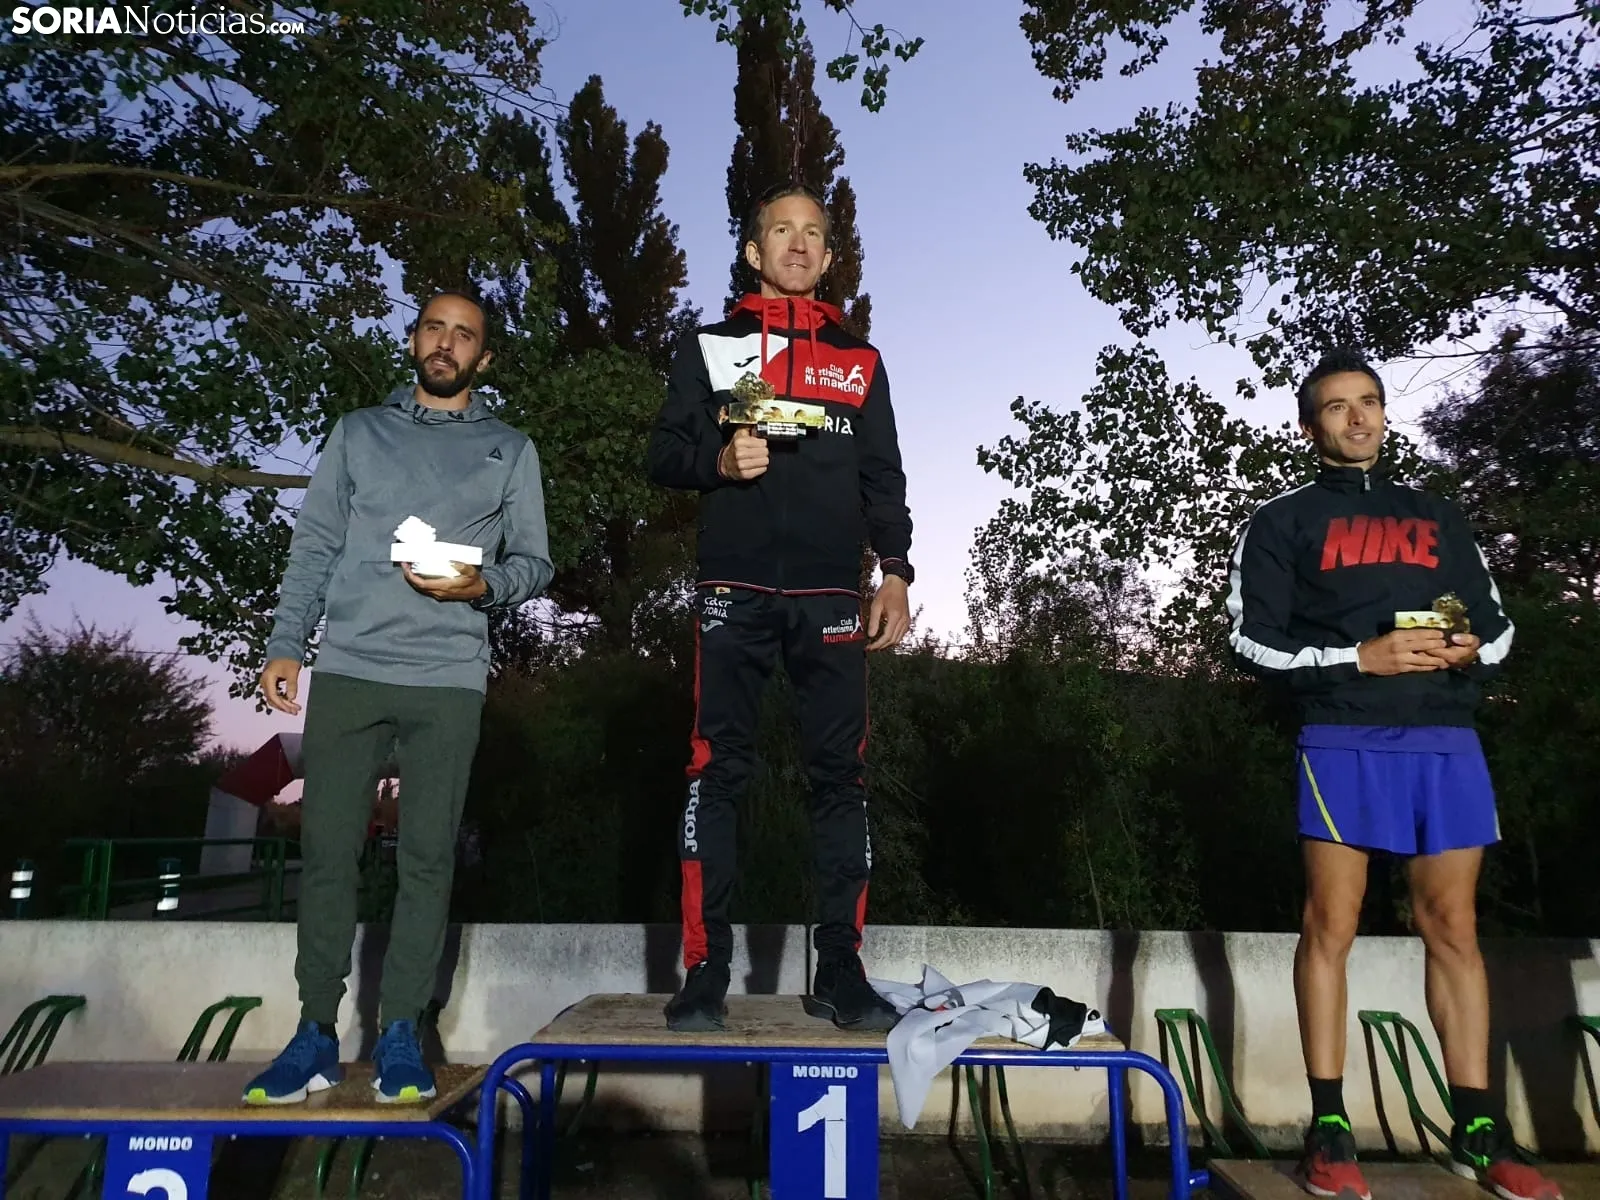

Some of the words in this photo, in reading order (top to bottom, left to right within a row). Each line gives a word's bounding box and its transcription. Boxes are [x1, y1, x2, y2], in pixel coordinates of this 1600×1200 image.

[1320, 515, 1439, 571] NIKE
[793, 1065, 858, 1079] MONDO
[128, 1136, 193, 1151] MONDO
[798, 1085, 847, 1199] 1
